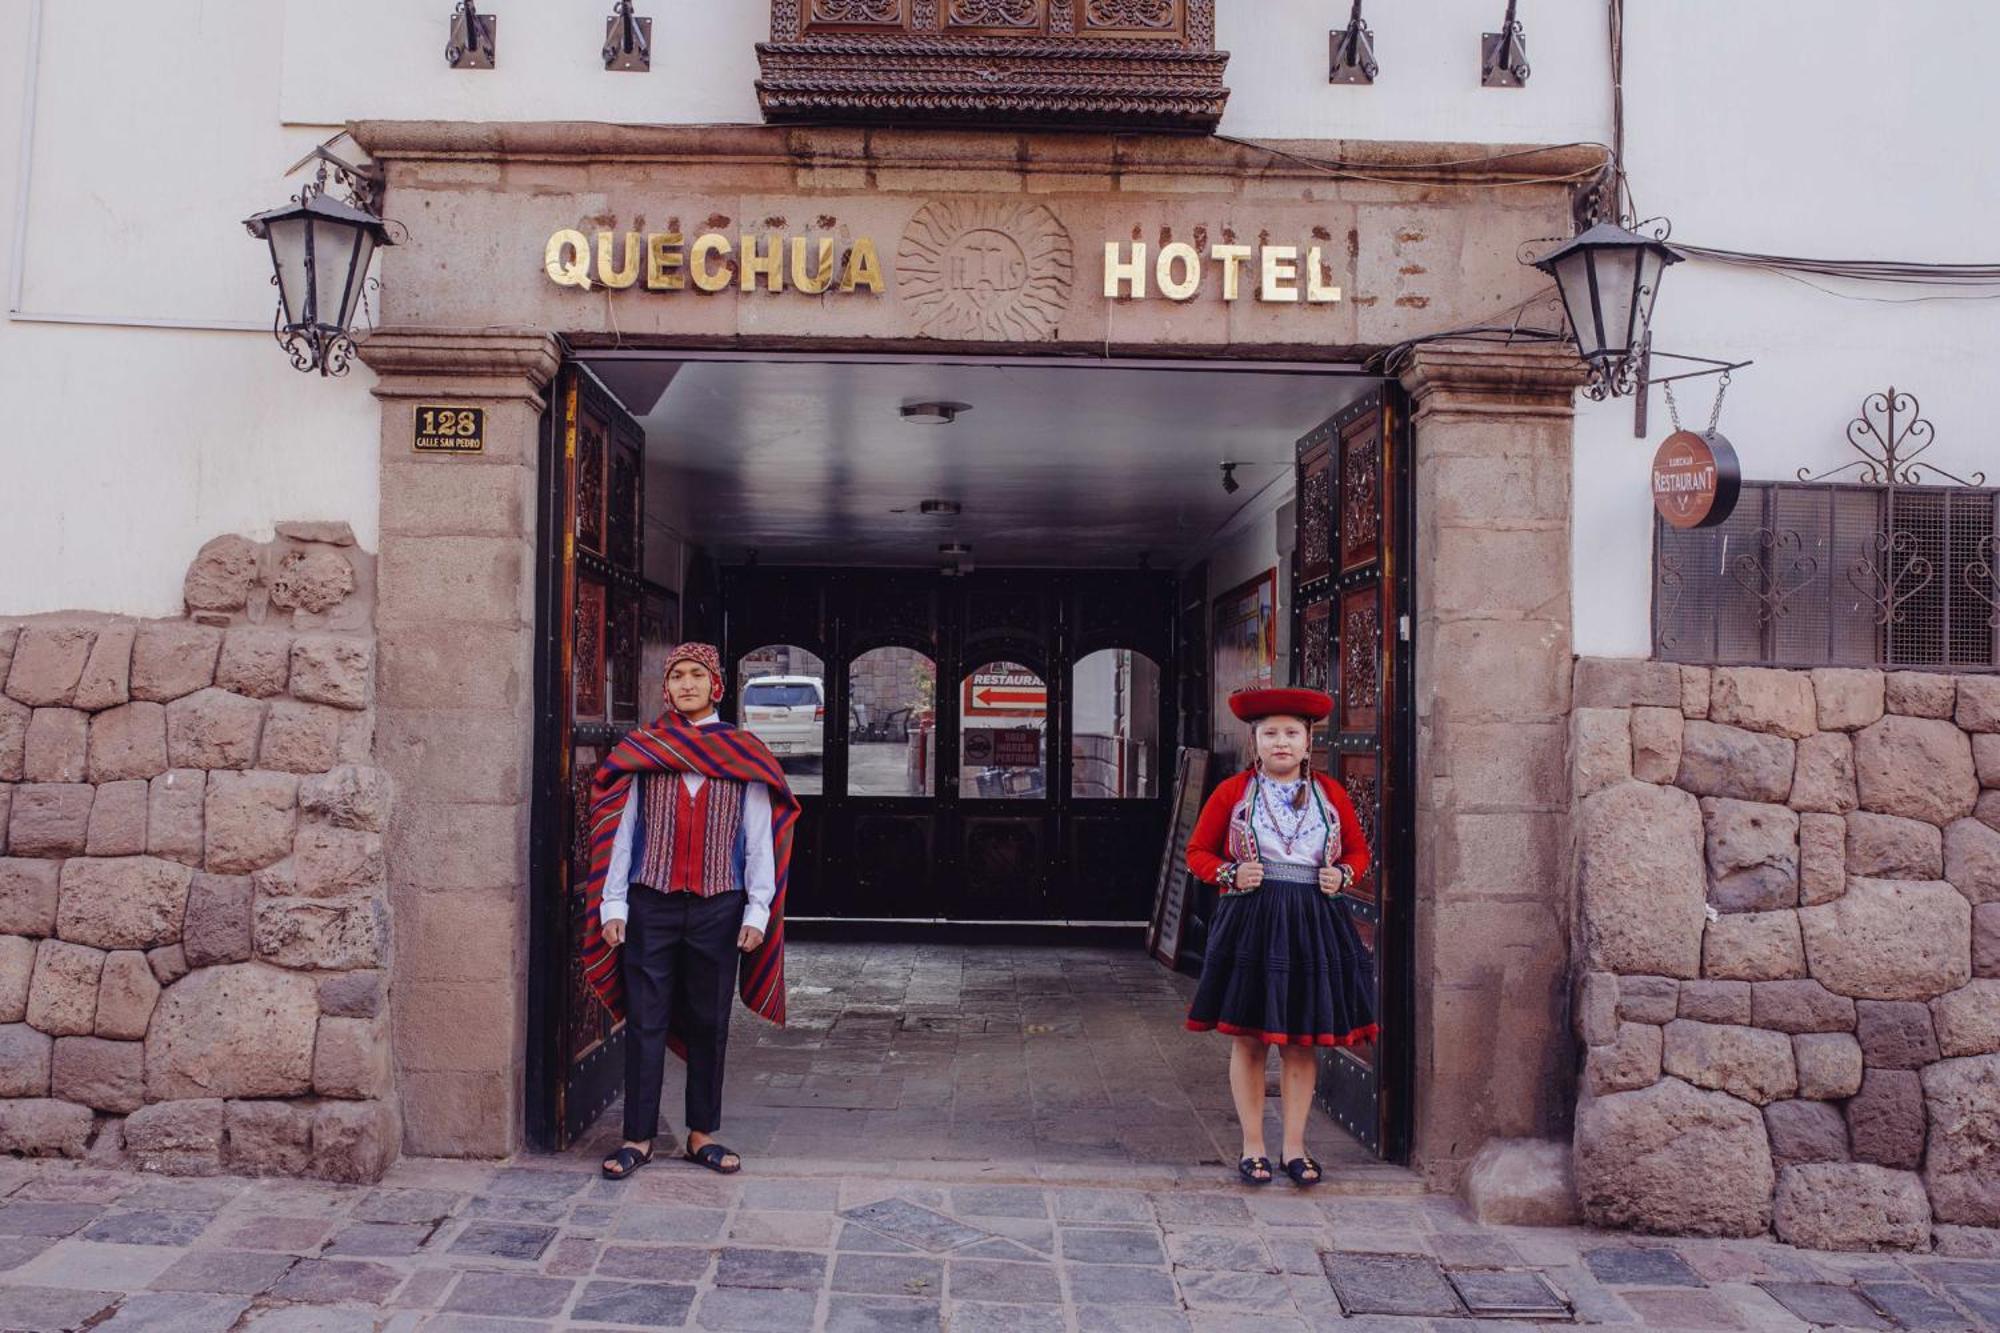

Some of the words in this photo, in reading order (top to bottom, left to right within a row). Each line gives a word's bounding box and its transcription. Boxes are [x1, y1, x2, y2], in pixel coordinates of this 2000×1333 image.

[544, 229, 884, 294] QUECHUA
[1104, 241, 1342, 302] HOTEL
[423, 411, 475, 435] 128
[416, 437, 439, 447] CALLE
[440, 438, 455, 448] SAN
[456, 438, 480, 448] PEDRO
[1654, 467, 1714, 492] RESTAURANT
[974, 675, 1045, 685] RESTAURA
